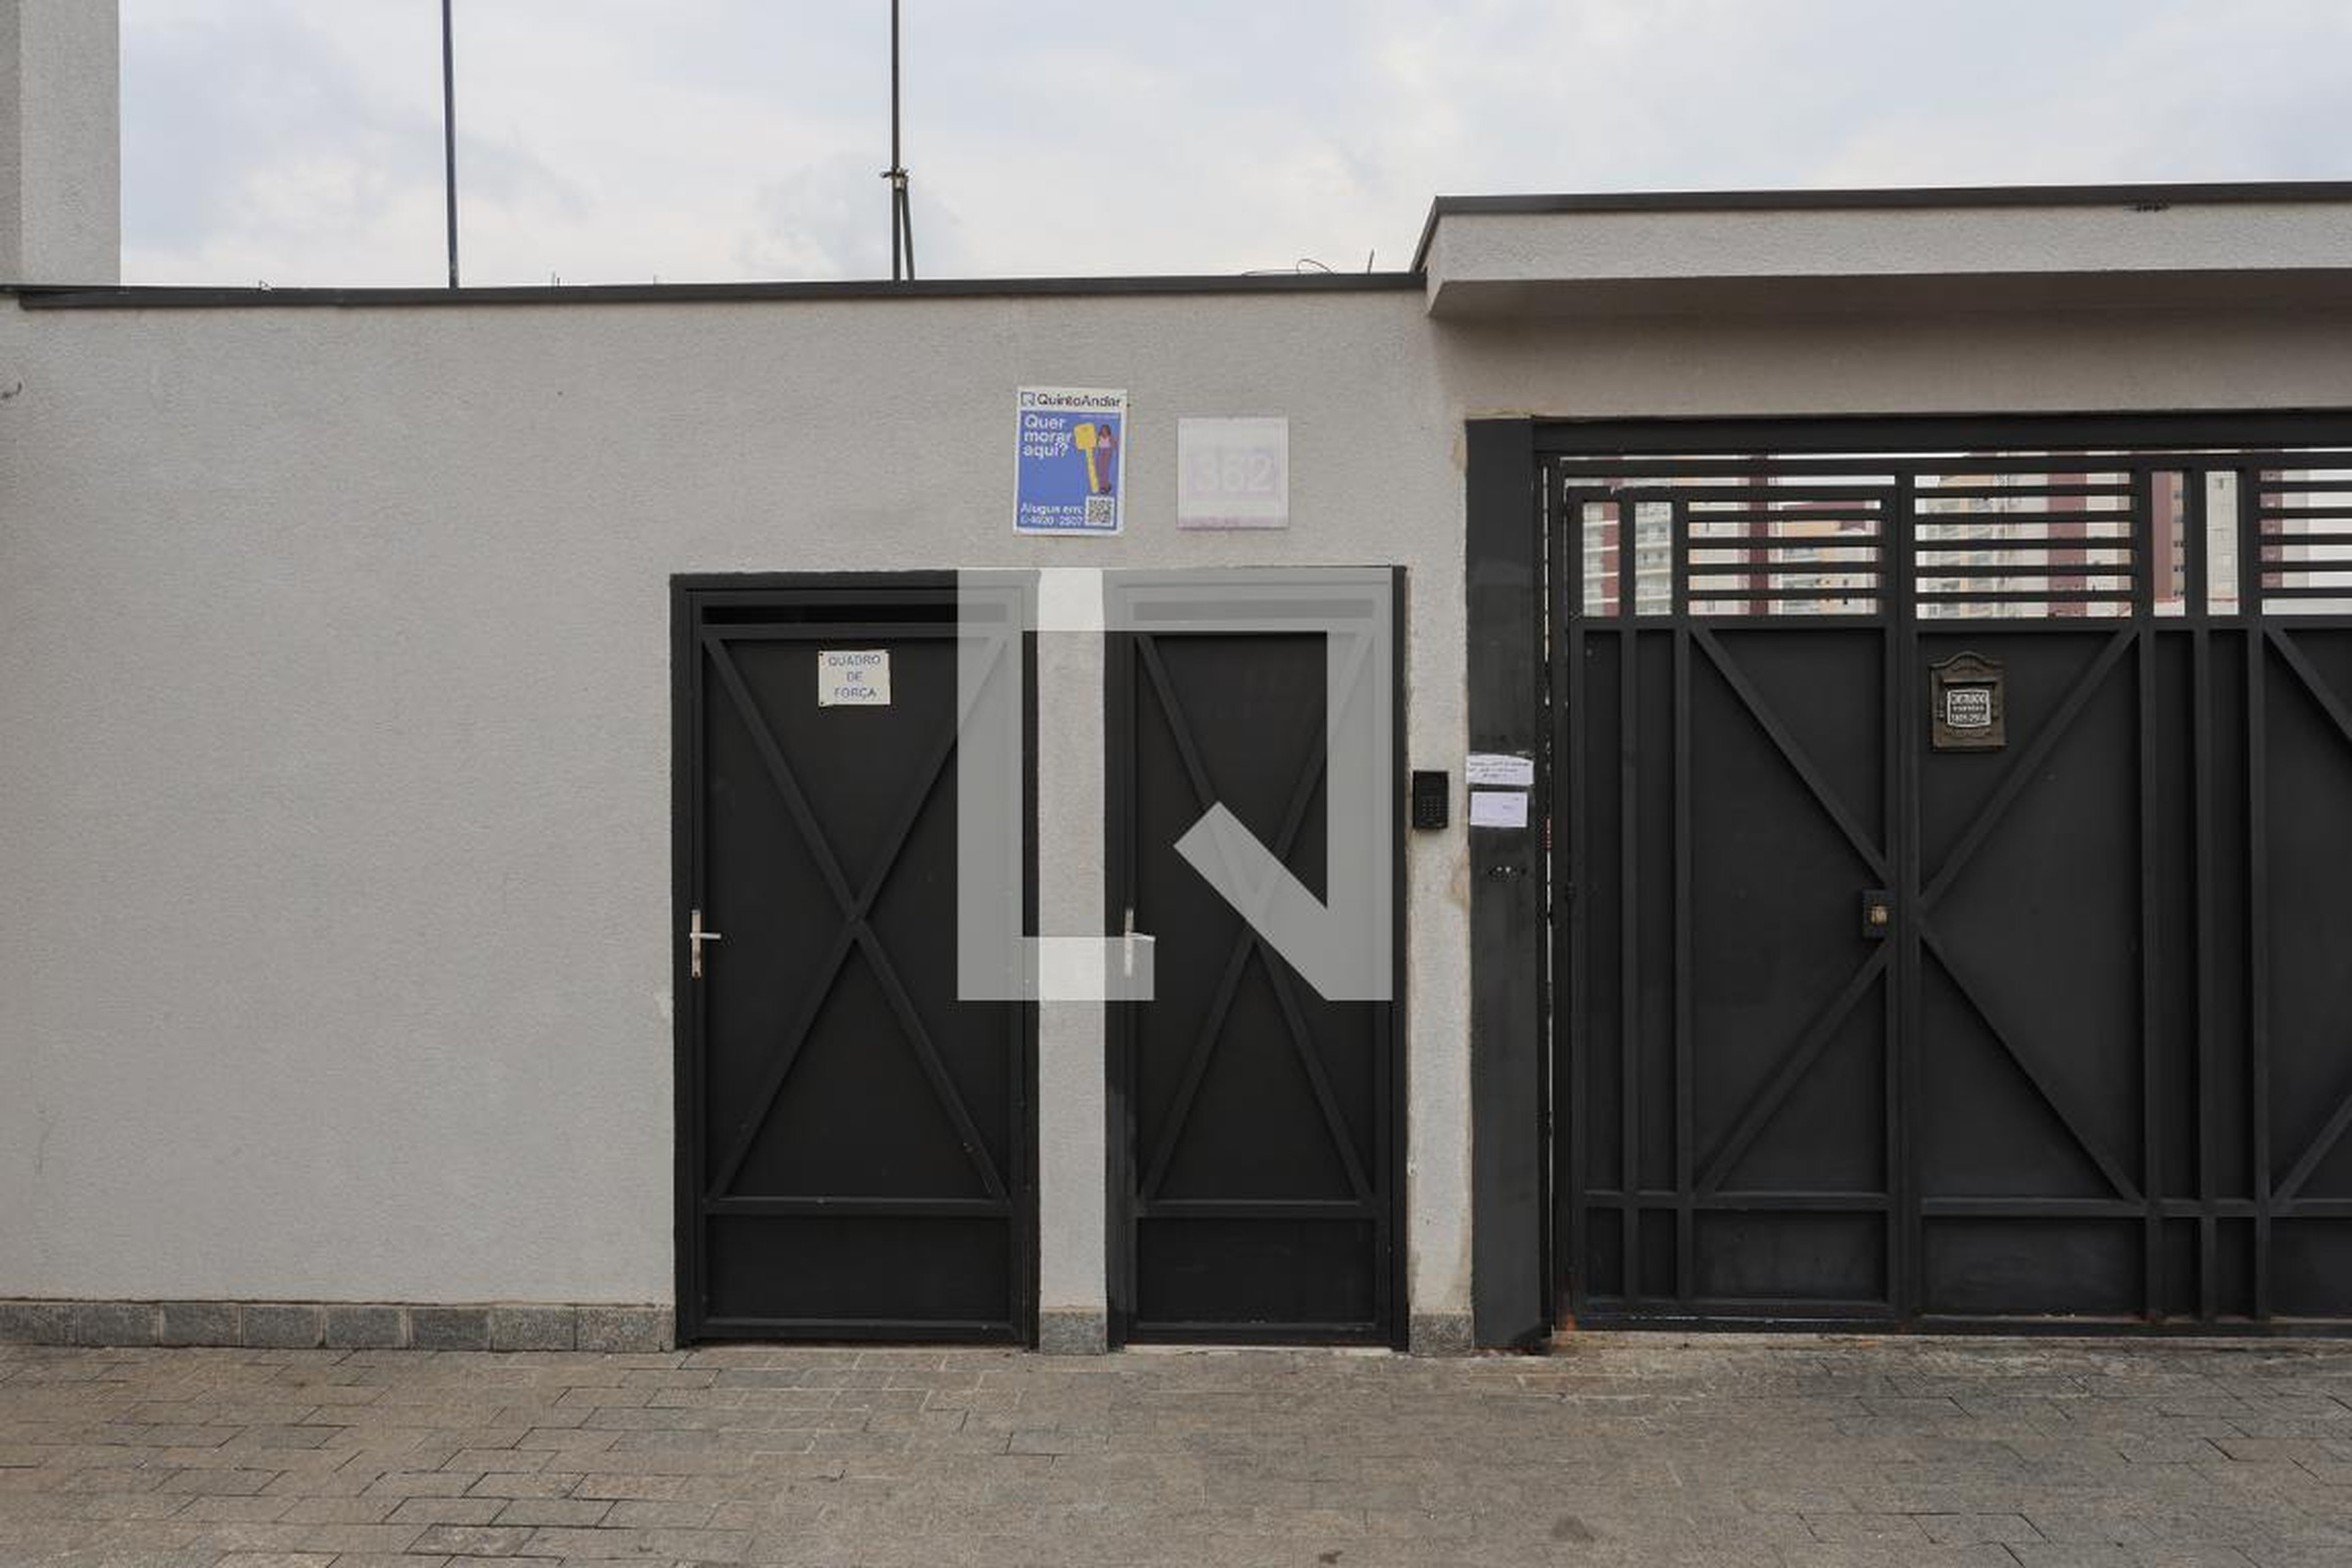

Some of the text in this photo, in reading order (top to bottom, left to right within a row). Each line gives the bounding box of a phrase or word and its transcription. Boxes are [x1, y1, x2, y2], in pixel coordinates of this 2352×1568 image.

[1037, 393, 1120, 407] QuintoAndar
[1024, 414, 1066, 429] Quer
[1023, 431, 1072, 443] morar
[1022, 443, 1069, 458] aqui?
[828, 654, 881, 666] QUADRO
[846, 671, 863, 682] DE
